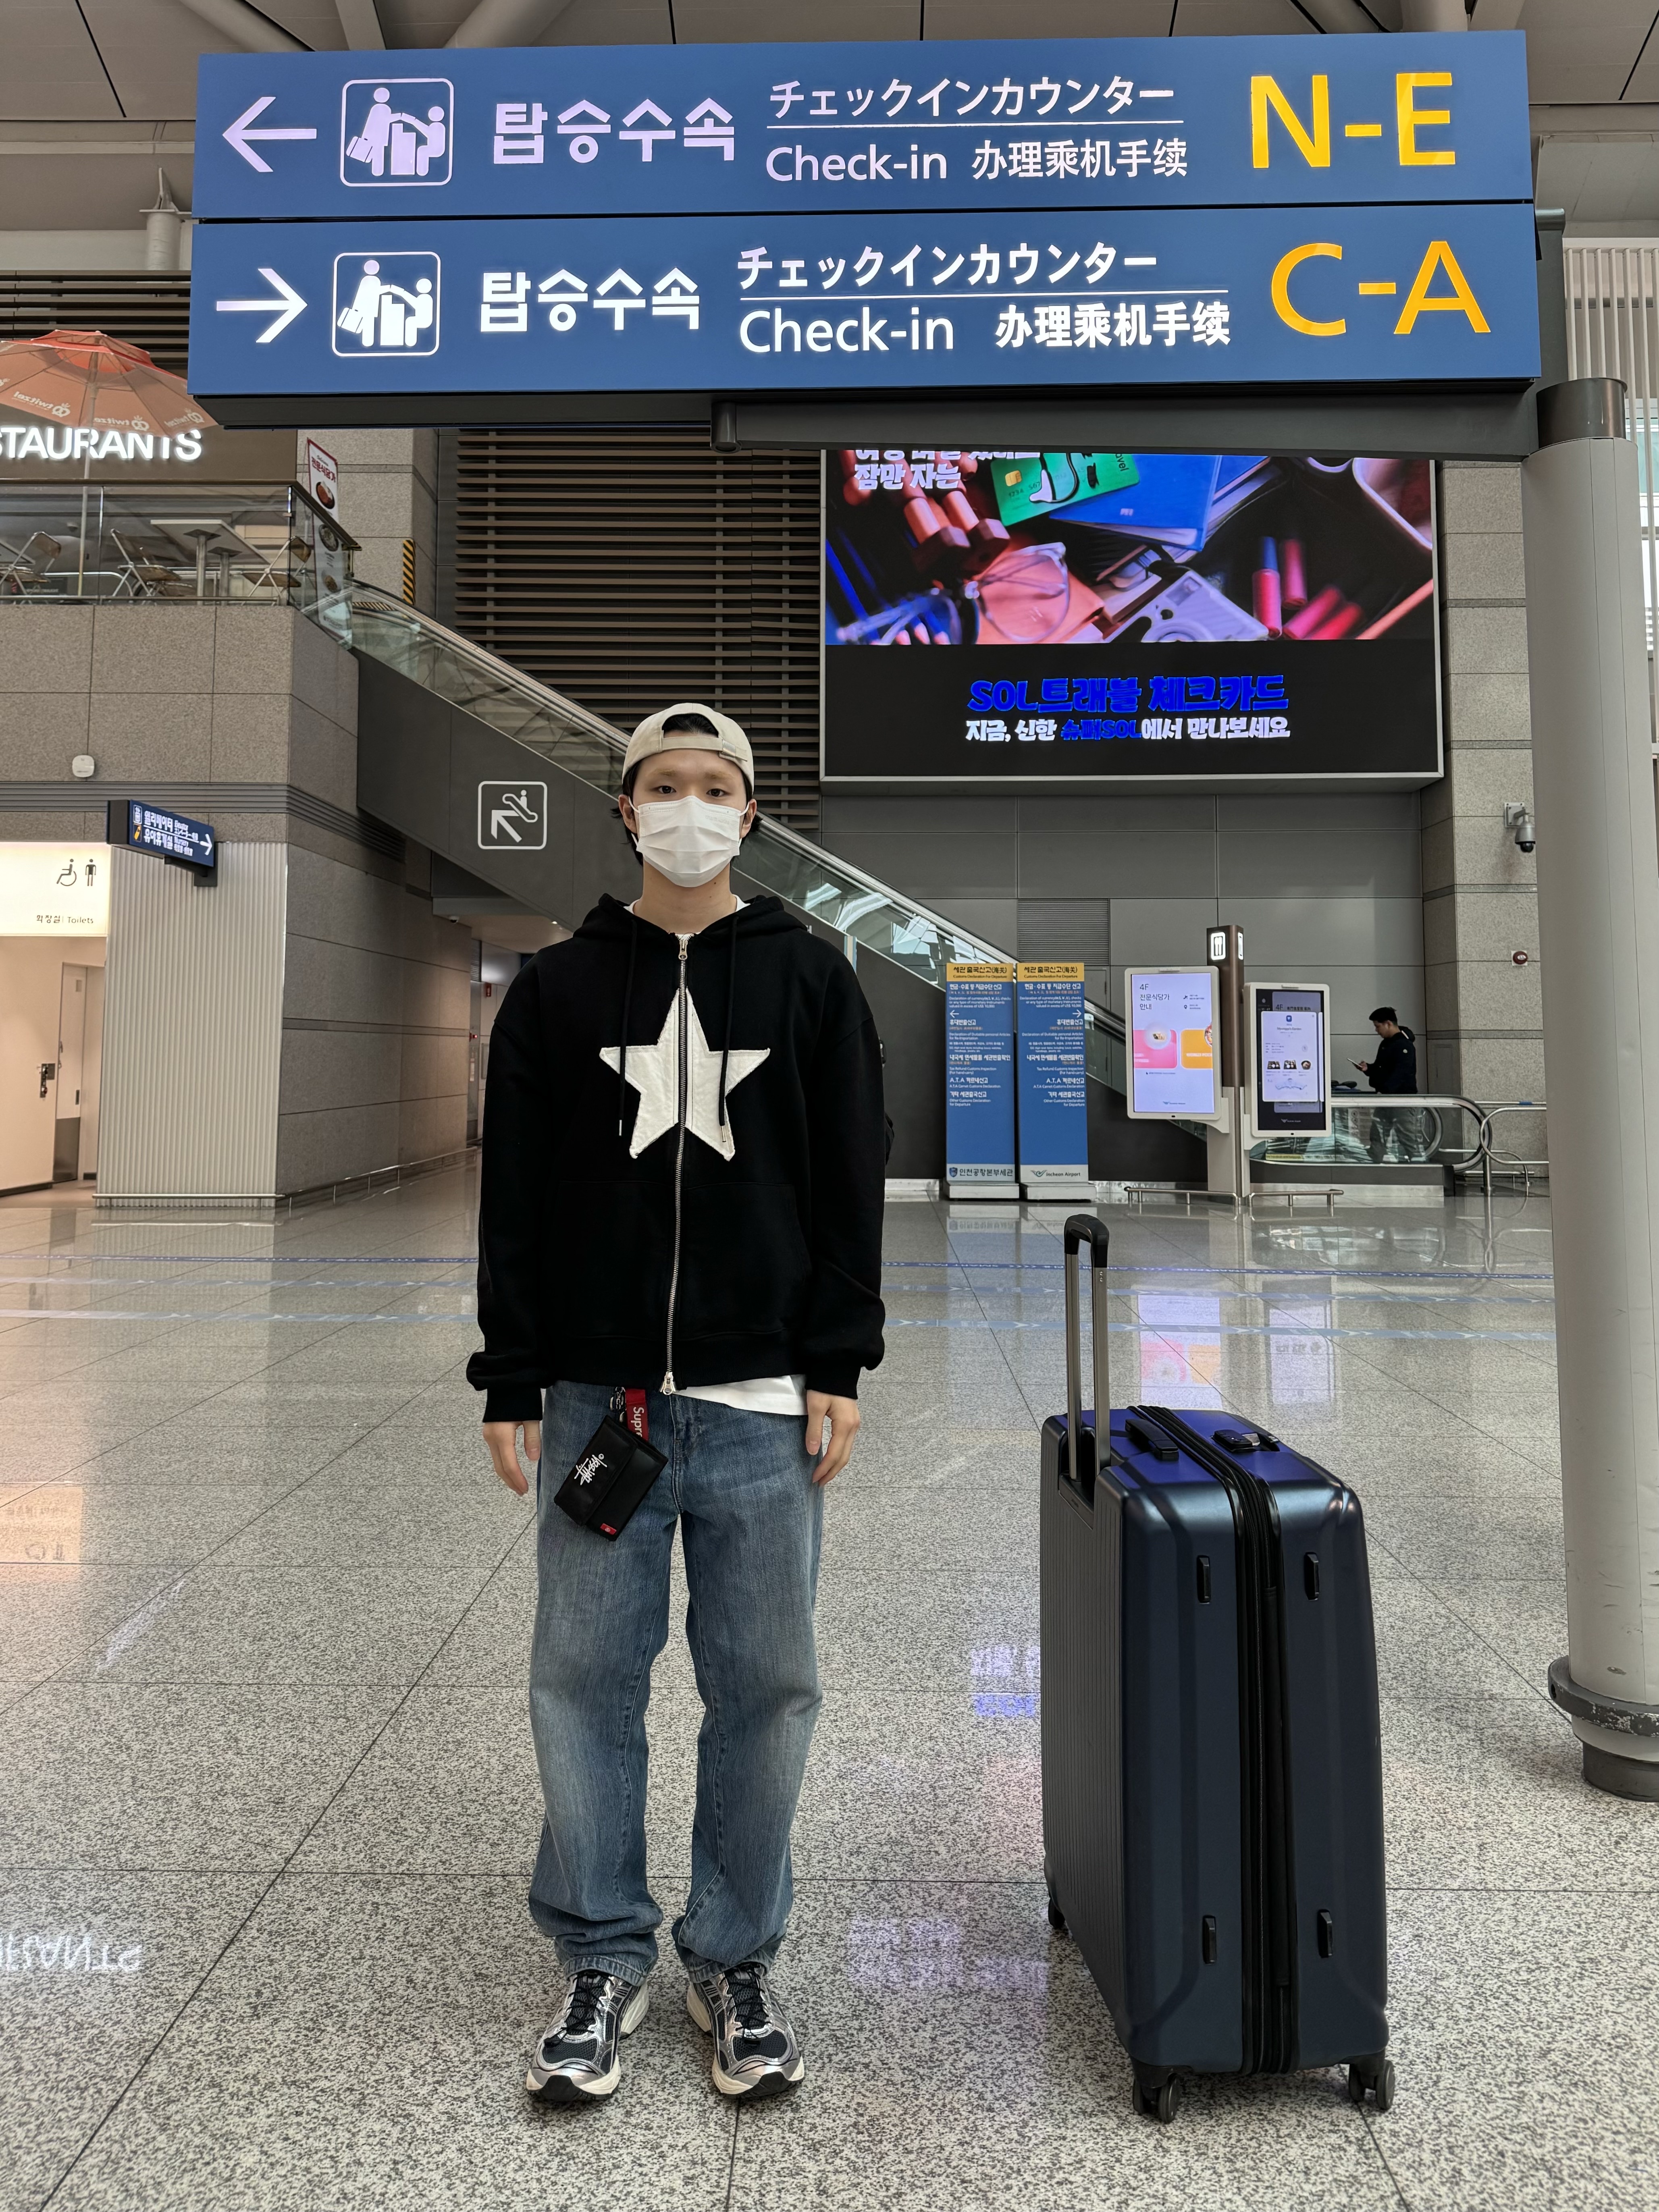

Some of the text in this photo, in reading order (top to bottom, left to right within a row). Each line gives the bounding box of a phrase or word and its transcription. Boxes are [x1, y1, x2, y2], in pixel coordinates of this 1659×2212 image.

[769, 75, 1173, 120] チェックインカウンター
[493, 98, 734, 165] 탑승수속
[1250, 72, 1455, 168] N-E
[765, 144, 947, 181] Check-in
[972, 138, 1187, 180] 办理乘机手续
[737, 243, 1157, 289] チェックインカウンター
[480, 266, 700, 332] 탑승수속
[1271, 241, 1491, 336] C-A
[738, 309, 955, 354] Check-in
[995, 301, 1230, 349] 办理乘机手续
[0, 427, 202, 461] TAURANTS
[854, 463, 961, 490] 잠만 자는
[967, 675, 1289, 713] SOL트래블 체크카드
[965, 717, 1291, 742] 지금, 신한 슈퍼SOL에서 만나보세요
[144, 810, 173, 832] 엘리베이터
[144, 829, 173, 850] 유아휴게실
